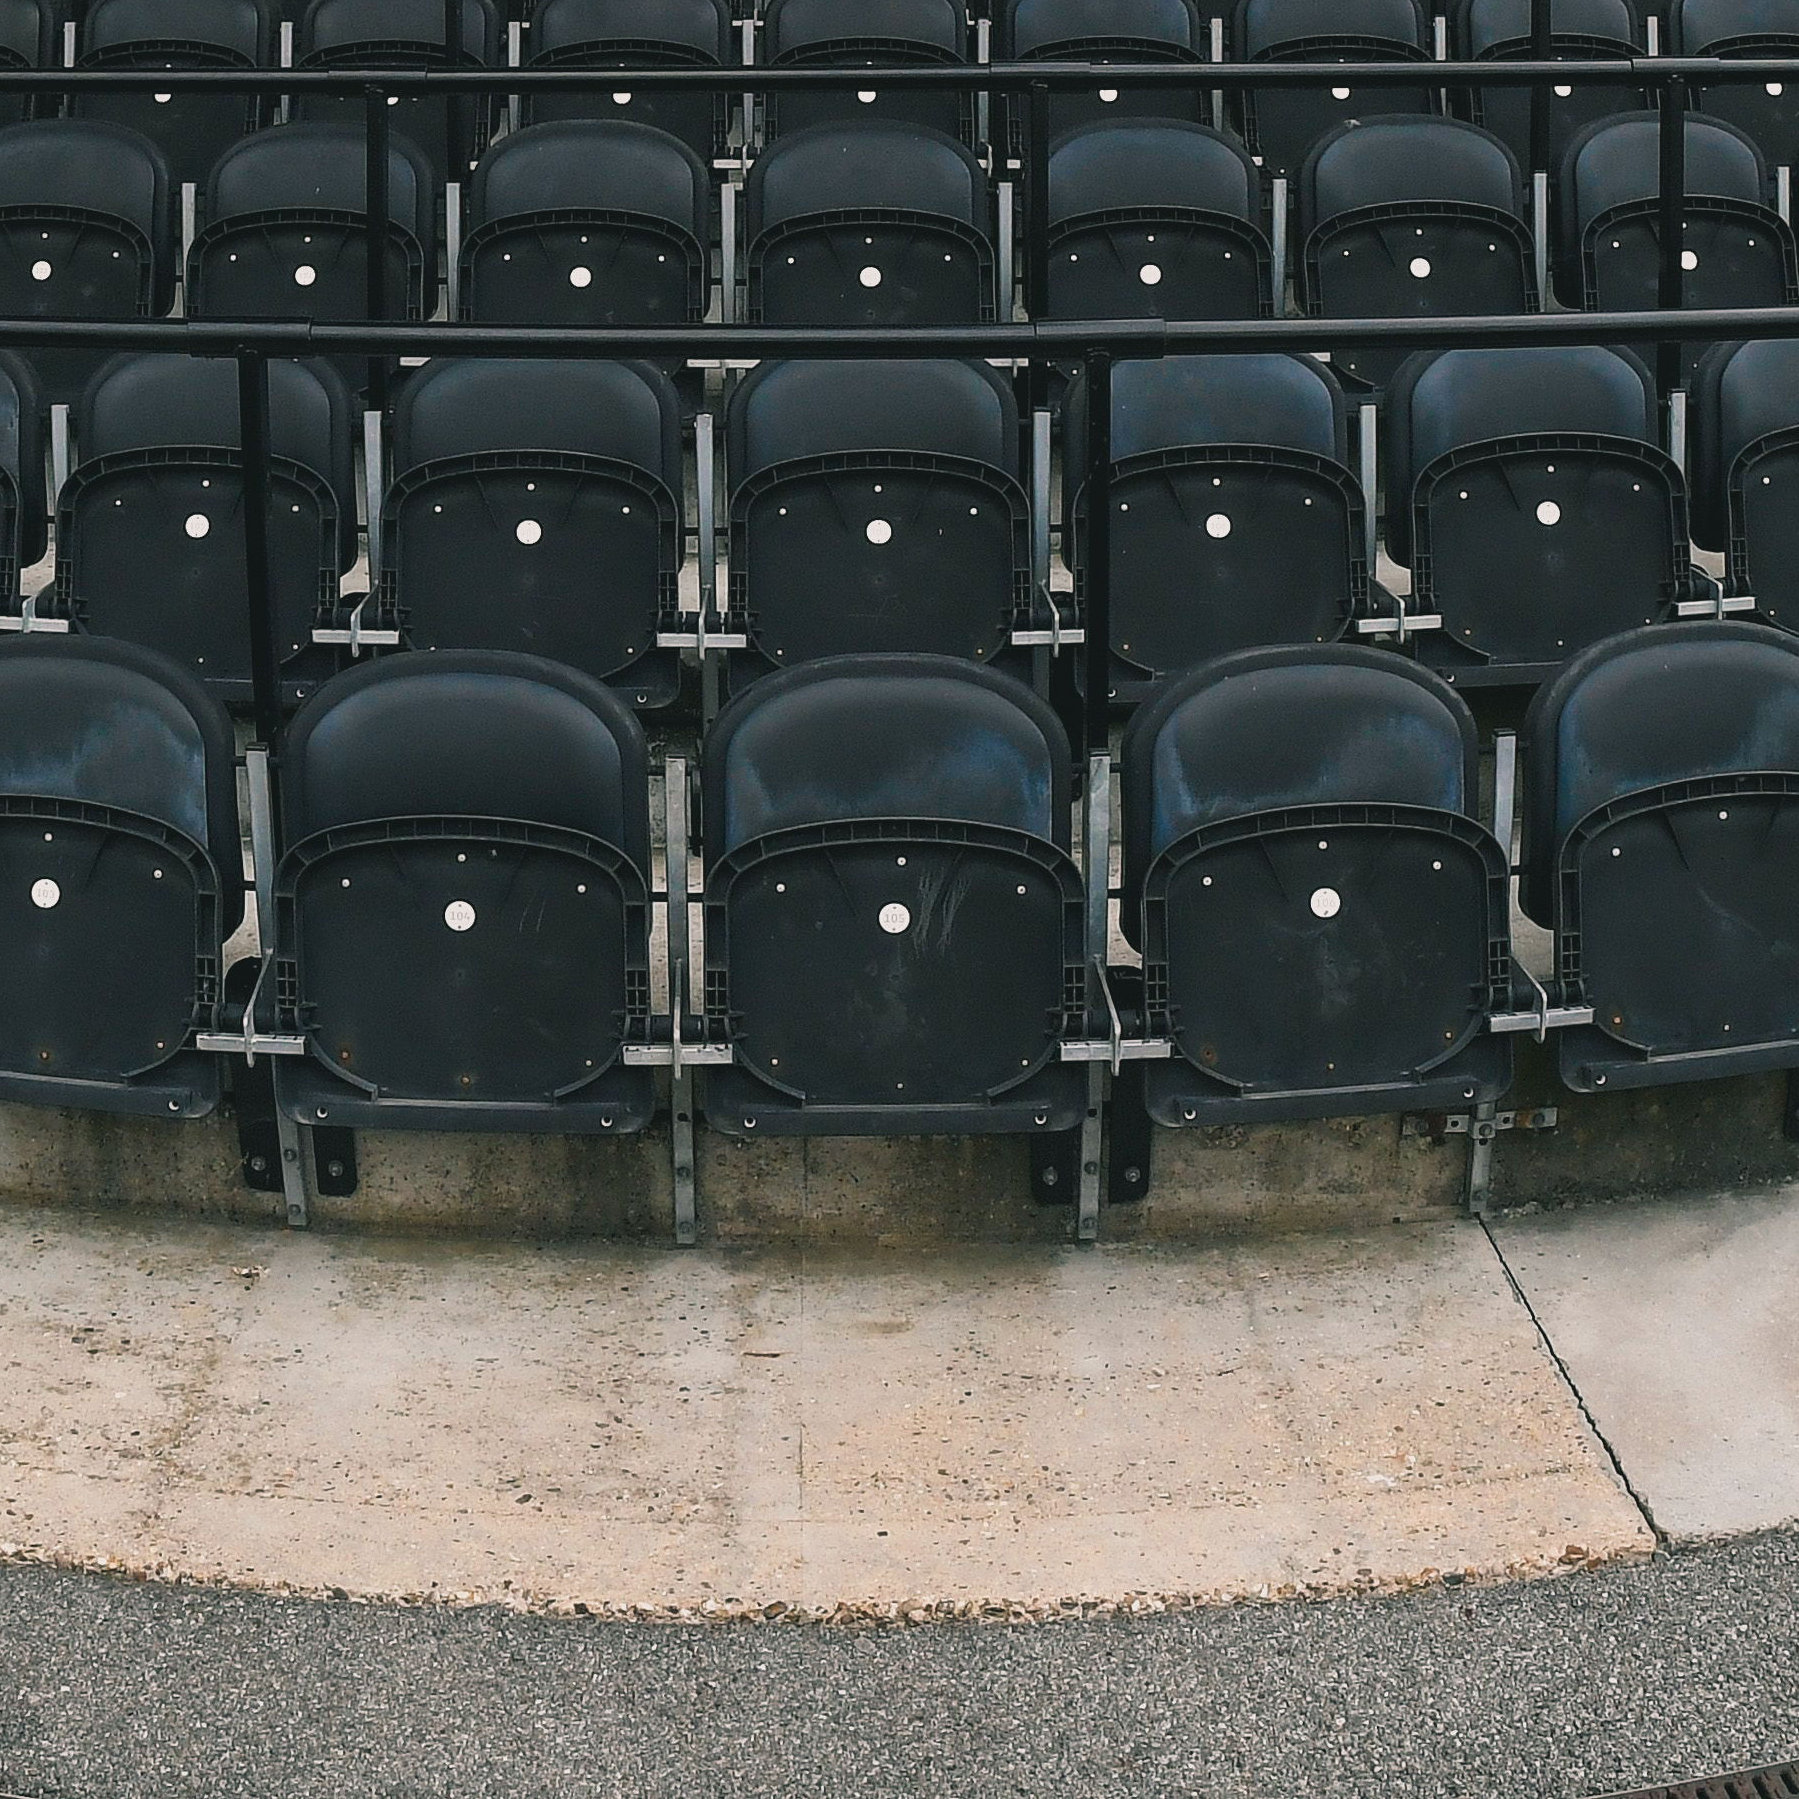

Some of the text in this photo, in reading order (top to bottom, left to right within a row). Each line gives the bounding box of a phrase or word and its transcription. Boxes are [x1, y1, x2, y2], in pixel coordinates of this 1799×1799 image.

[36, 888, 55, 899] 103
[1315, 898, 1336, 908] 106
[449, 911, 471, 921] 104
[884, 913, 905, 923] 105
